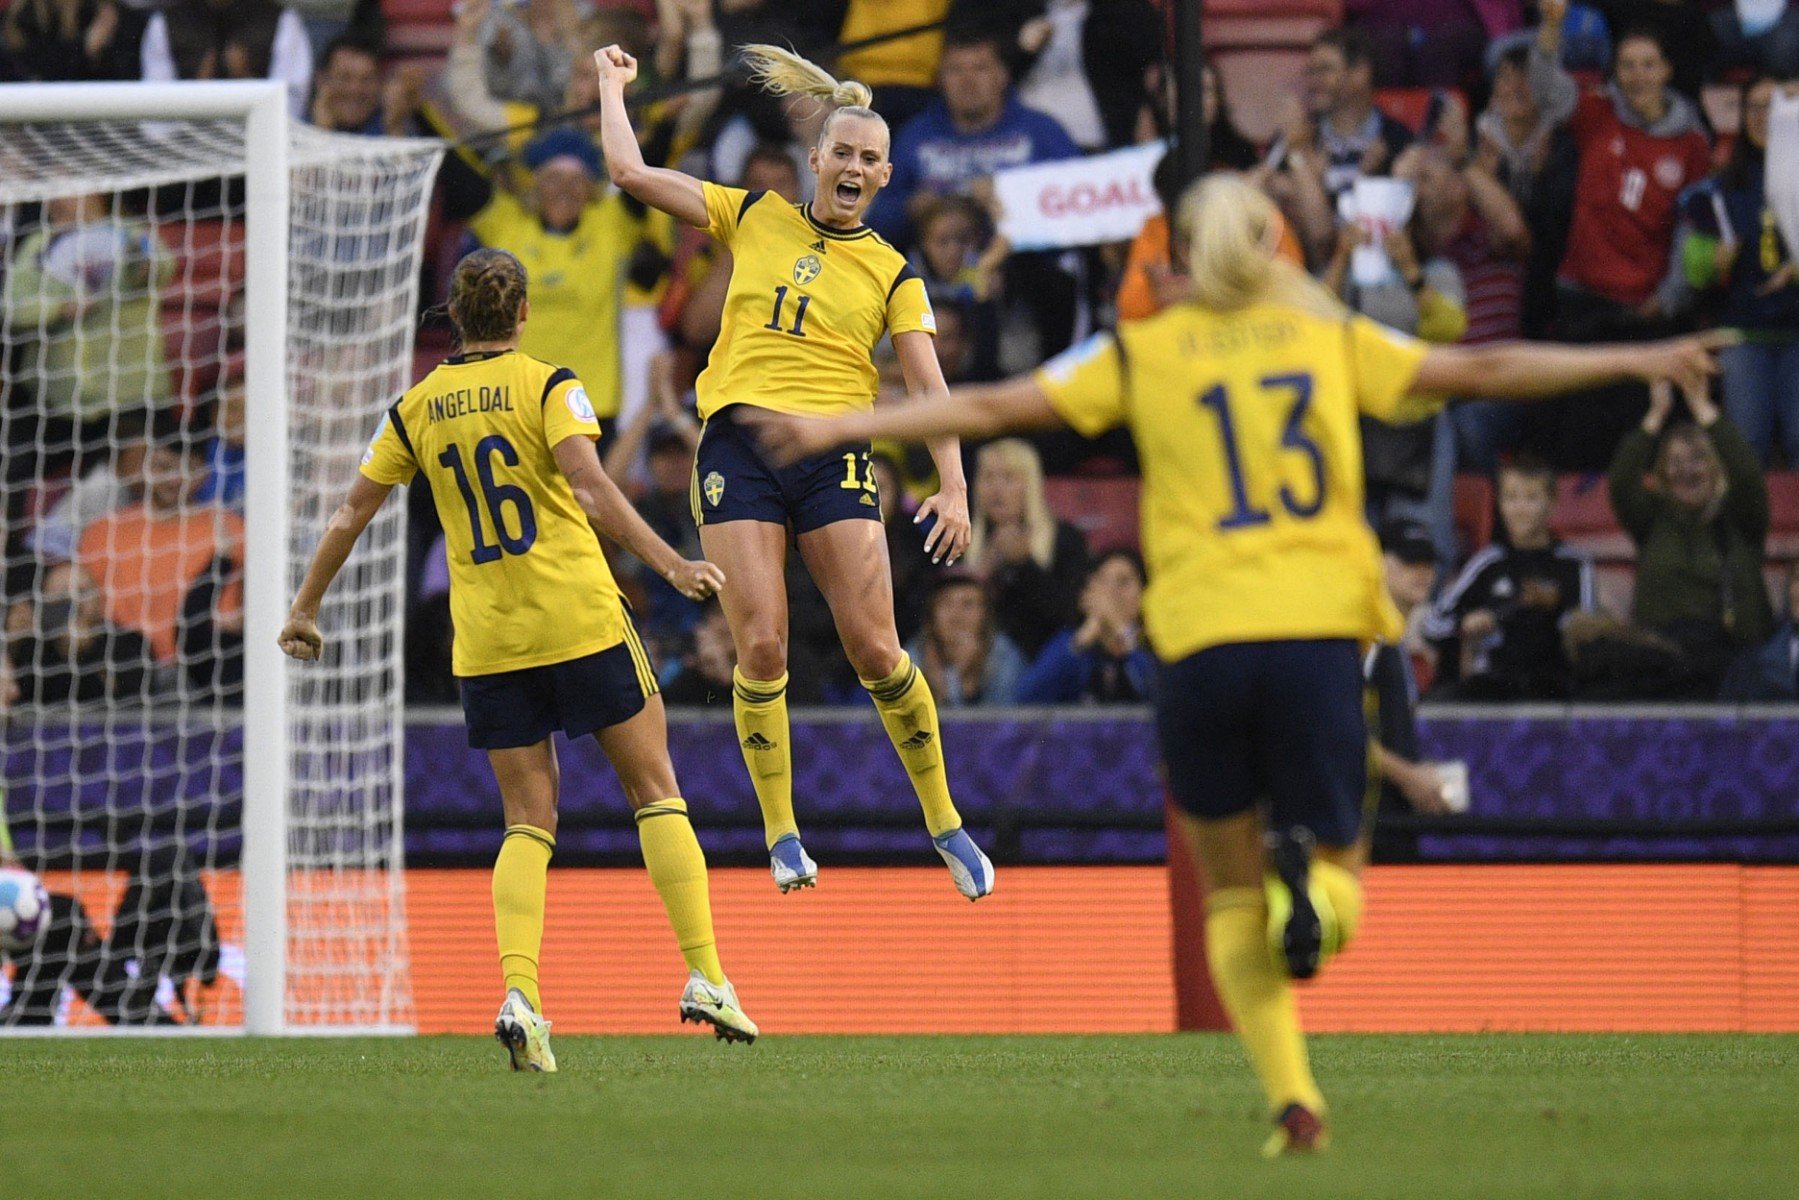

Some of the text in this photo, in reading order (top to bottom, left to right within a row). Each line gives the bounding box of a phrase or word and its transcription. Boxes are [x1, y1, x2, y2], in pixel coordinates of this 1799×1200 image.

[1038, 177, 1148, 219] GOAL
[764, 285, 810, 337] 11
[427, 385, 514, 426] ANGELDAL
[840, 452, 877, 494] 11
[1198, 372, 1328, 533] 13
[438, 434, 538, 566] 16
